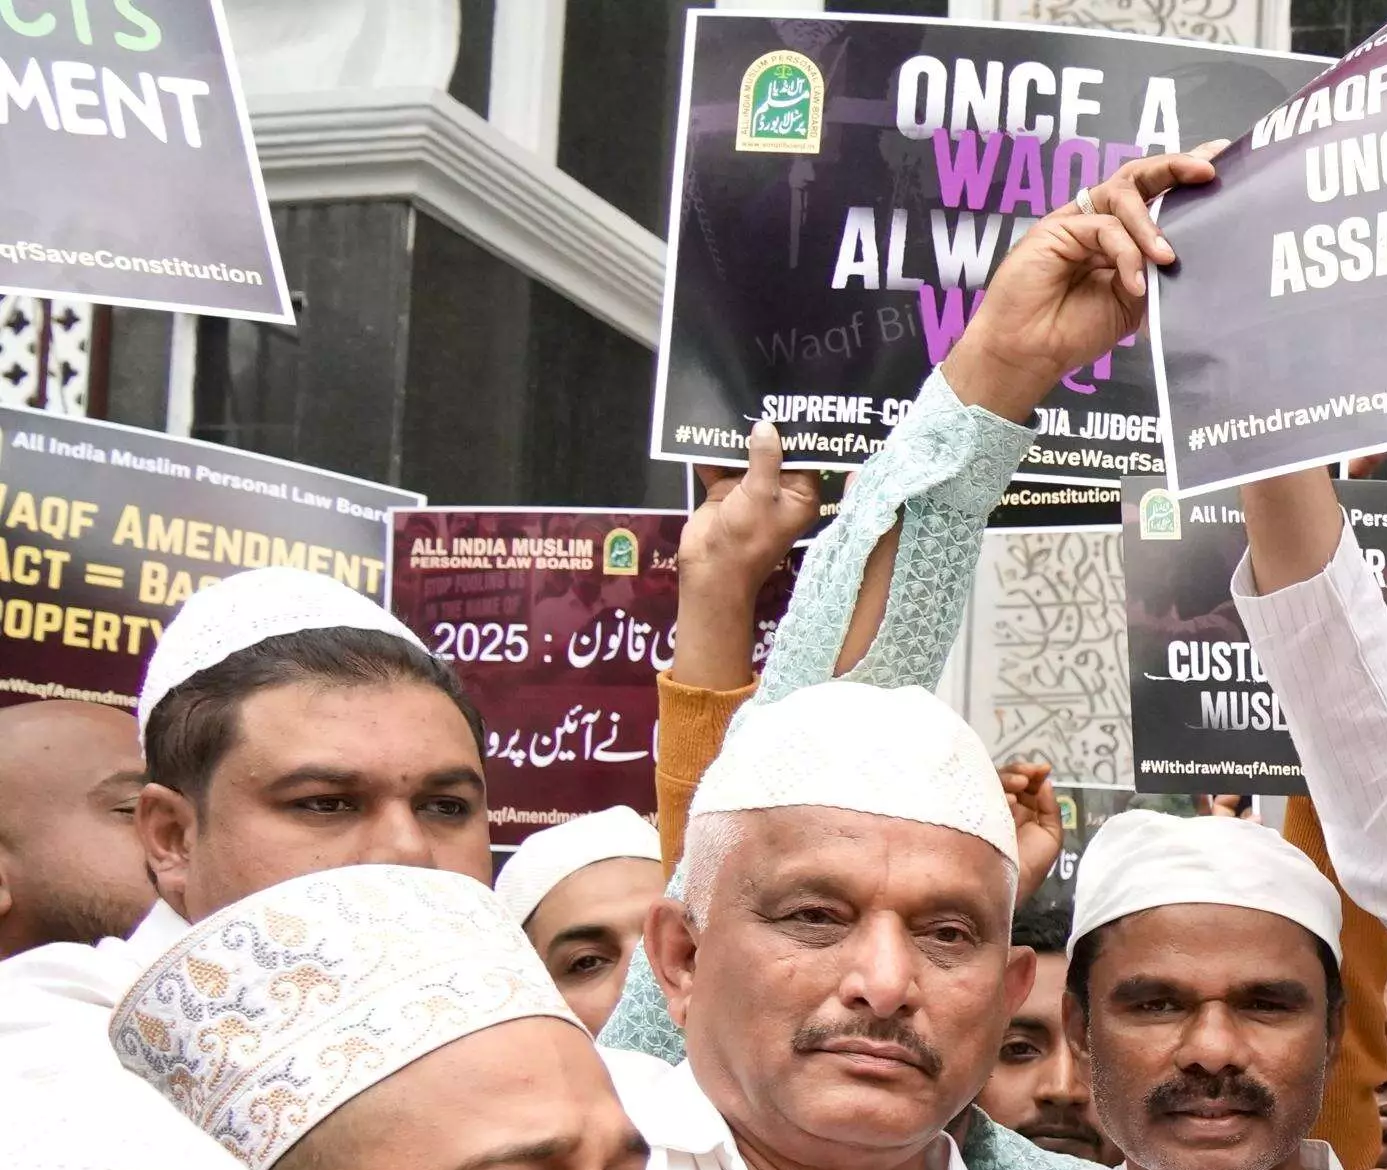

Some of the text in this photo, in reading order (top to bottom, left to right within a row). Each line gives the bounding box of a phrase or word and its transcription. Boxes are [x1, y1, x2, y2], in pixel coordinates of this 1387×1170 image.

[896, 55, 1181, 156] ONCE A
[761, 395, 873, 424] SUPREME
[12, 431, 44, 452] All
[50, 437, 106, 464] India
[111, 449, 191, 479] Muslim
[196, 465, 288, 500] Personal
[292, 485, 341, 511] Law
[1190, 506, 1217, 523] All
[0, 484, 384, 594] AQF AMENDMENT
[411, 538, 593, 557] ALL INDIA MUSLIM
[410, 557, 593, 570] PERSONAL LAW BOARD
[433, 622, 529, 663] 2025
[567, 608, 652, 669] قانون
